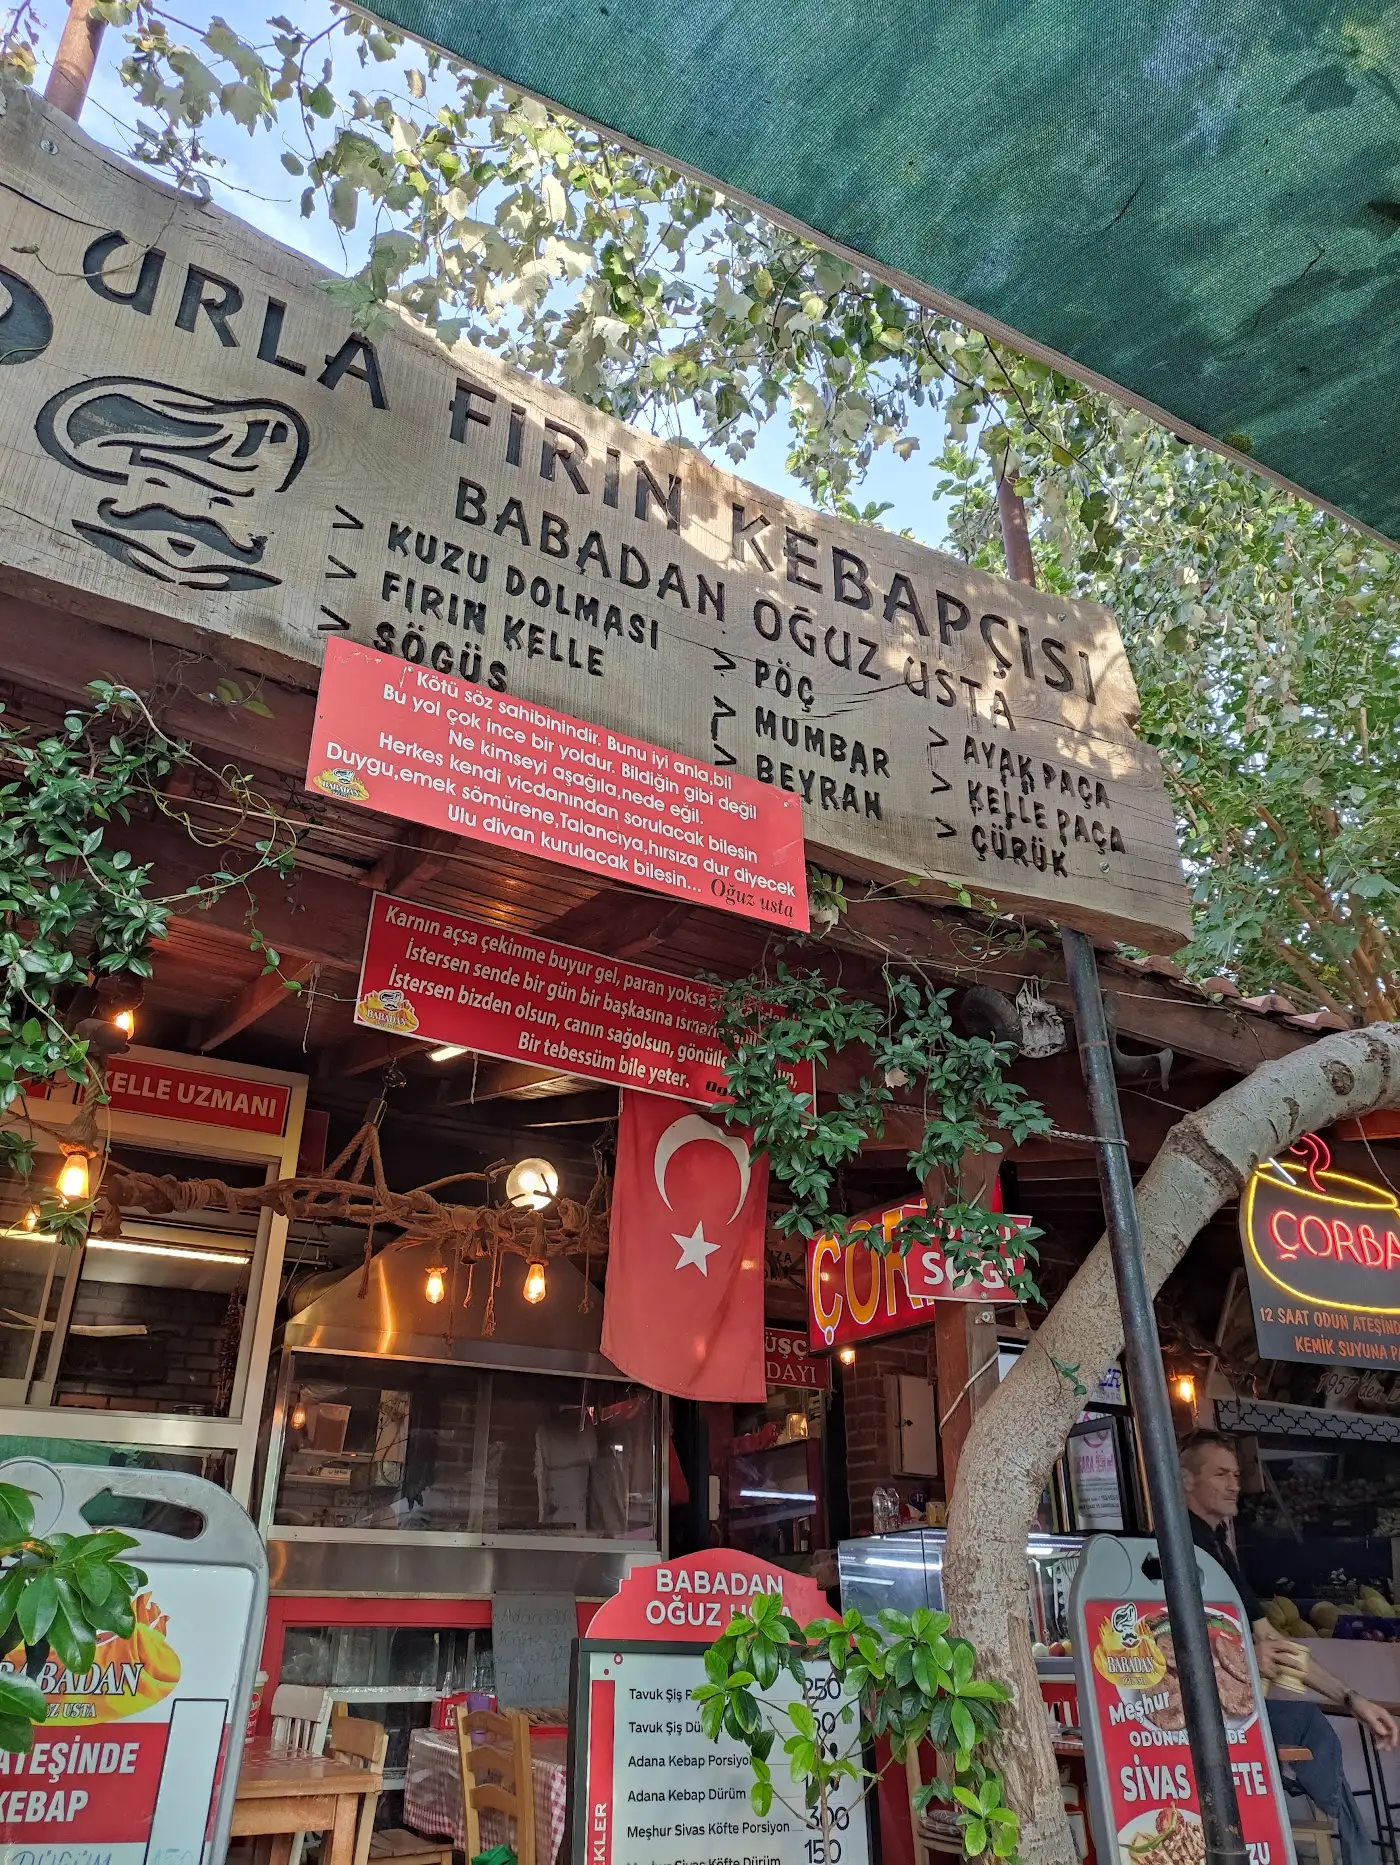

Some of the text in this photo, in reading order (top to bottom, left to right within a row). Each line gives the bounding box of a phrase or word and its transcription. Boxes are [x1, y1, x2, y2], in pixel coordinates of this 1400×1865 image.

[83, 229, 1096, 706] URLA FIRIN KEBAPÇISI
[387, 521, 658, 650] KUZU DOLMASI
[455, 476, 1016, 733] BABADAN OĞUZ USTA
[382, 570, 604, 677] FIRIN KELLE
[756, 658, 815, 713] PÖÇ
[383, 683, 757, 821] Bu yol çok ince bir yoldur. Bildiğin gibi değil
[417, 670, 732, 790] Kötü söz sahibinindir. Bunu iyi anla,bil
[756, 705, 890, 778] MUMBAR
[379, 731, 758, 864] Herkes kendi vicdanından sorulacak bilesin
[448, 729, 704, 826] Ne kimseyi aşağıla,nede eğil.
[756, 754, 883, 821] BEYRAN
[964, 735, 1110, 809] AYAK PAÇA
[326, 741, 457, 797] Duygu,emek
[703, 858, 730, 878] dur
[733, 864, 796, 898] diyecek
[968, 779, 1126, 855] KELLE PAÇA
[448, 803, 703, 893] Ulu divan kurulacak bilesin...
[972, 823, 1068, 878] ÇÜRÜK
[710, 878, 795, 918] Oğuz usta
[385, 904, 440, 936] Karnın
[443, 924, 478, 946] açsa
[480, 934, 546, 965] çekinme
[548, 949, 593, 977] buyur
[594, 964, 621, 987] gel,
[622, 973, 665, 997] paran
[668, 985, 707, 1009] yoksa
[405, 937, 470, 975] İstersen
[472, 962, 520, 987] sende
[522, 971, 546, 994] bir
[546, 982, 576, 1002] gün
[578, 987, 602, 1010] bir
[603, 992, 673, 1028] başkasına
[388, 964, 454, 1001] İstersen
[457, 985, 512, 1016] bizden
[514, 1001, 561, 1031] olsun,
[564, 1015, 604, 1038] canın
[606, 1027, 675, 1059] sağolsun,
[518, 1031, 690, 1089] Bir tebessüm bile yeter.
[177, 1082, 278, 1119] UZMANI
[1259, 1307, 1274, 1323] 12
[1277, 1309, 1310, 1326] SAAT
[1314, 1311, 1349, 1330] ODUN
[1295, 1334, 1336, 1355] KEMİK
[1338, 1340, 1388, 1360] SUYUNA
[646, 1594, 722, 1627] OĞUZ
[656, 1568, 783, 1597] BABADAN
[1107, 1656, 1155, 1674] BABADAN
[63, 1703, 98, 1719] USTA
[629, 1688, 663, 1701] Tavuk
[666, 1688, 683, 1703] Şiş
[1108, 1691, 1170, 1726] Meşhur
[628, 1721, 663, 1734] Tavuk
[666, 1721, 683, 1736] Şiş
[1129, 1731, 1173, 1747] ODUN
[628, 1755, 666, 1768] Adana
[668, 1755, 706, 1769] Kebap
[1120, 1754, 1191, 1802] SİVAS
[627, 1787, 746, 1804] Adana Kebap Dürüm
[627, 1820, 790, 1841] Meşhur Sivas Köfte Porsiyon
